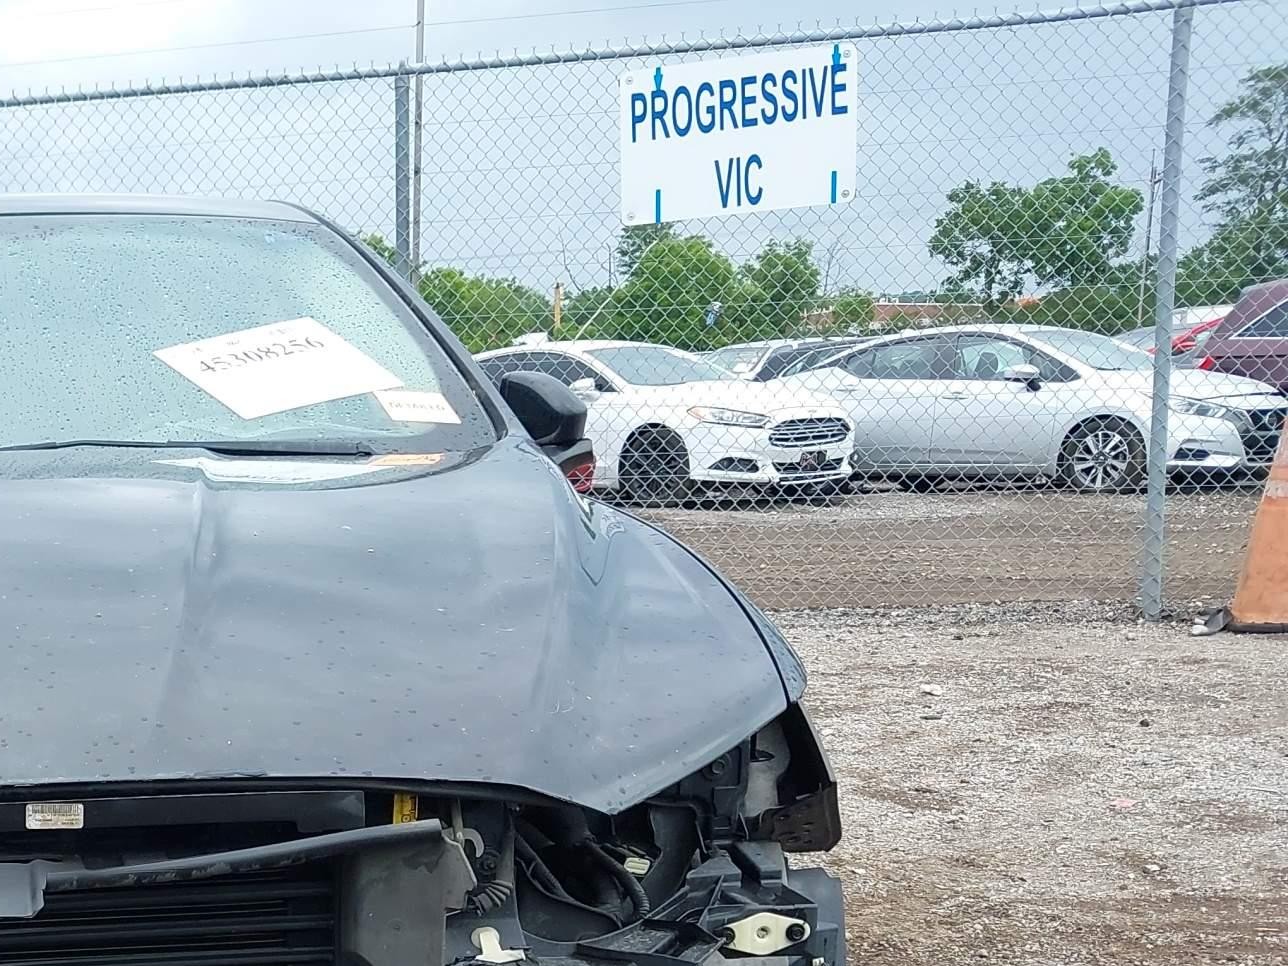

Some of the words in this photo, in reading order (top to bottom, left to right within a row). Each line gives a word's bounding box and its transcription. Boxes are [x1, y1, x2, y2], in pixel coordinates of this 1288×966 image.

[630, 62, 849, 144] PROGRESSIVE
[714, 153, 763, 208] VIC
[200, 336, 325, 373] 45308256
